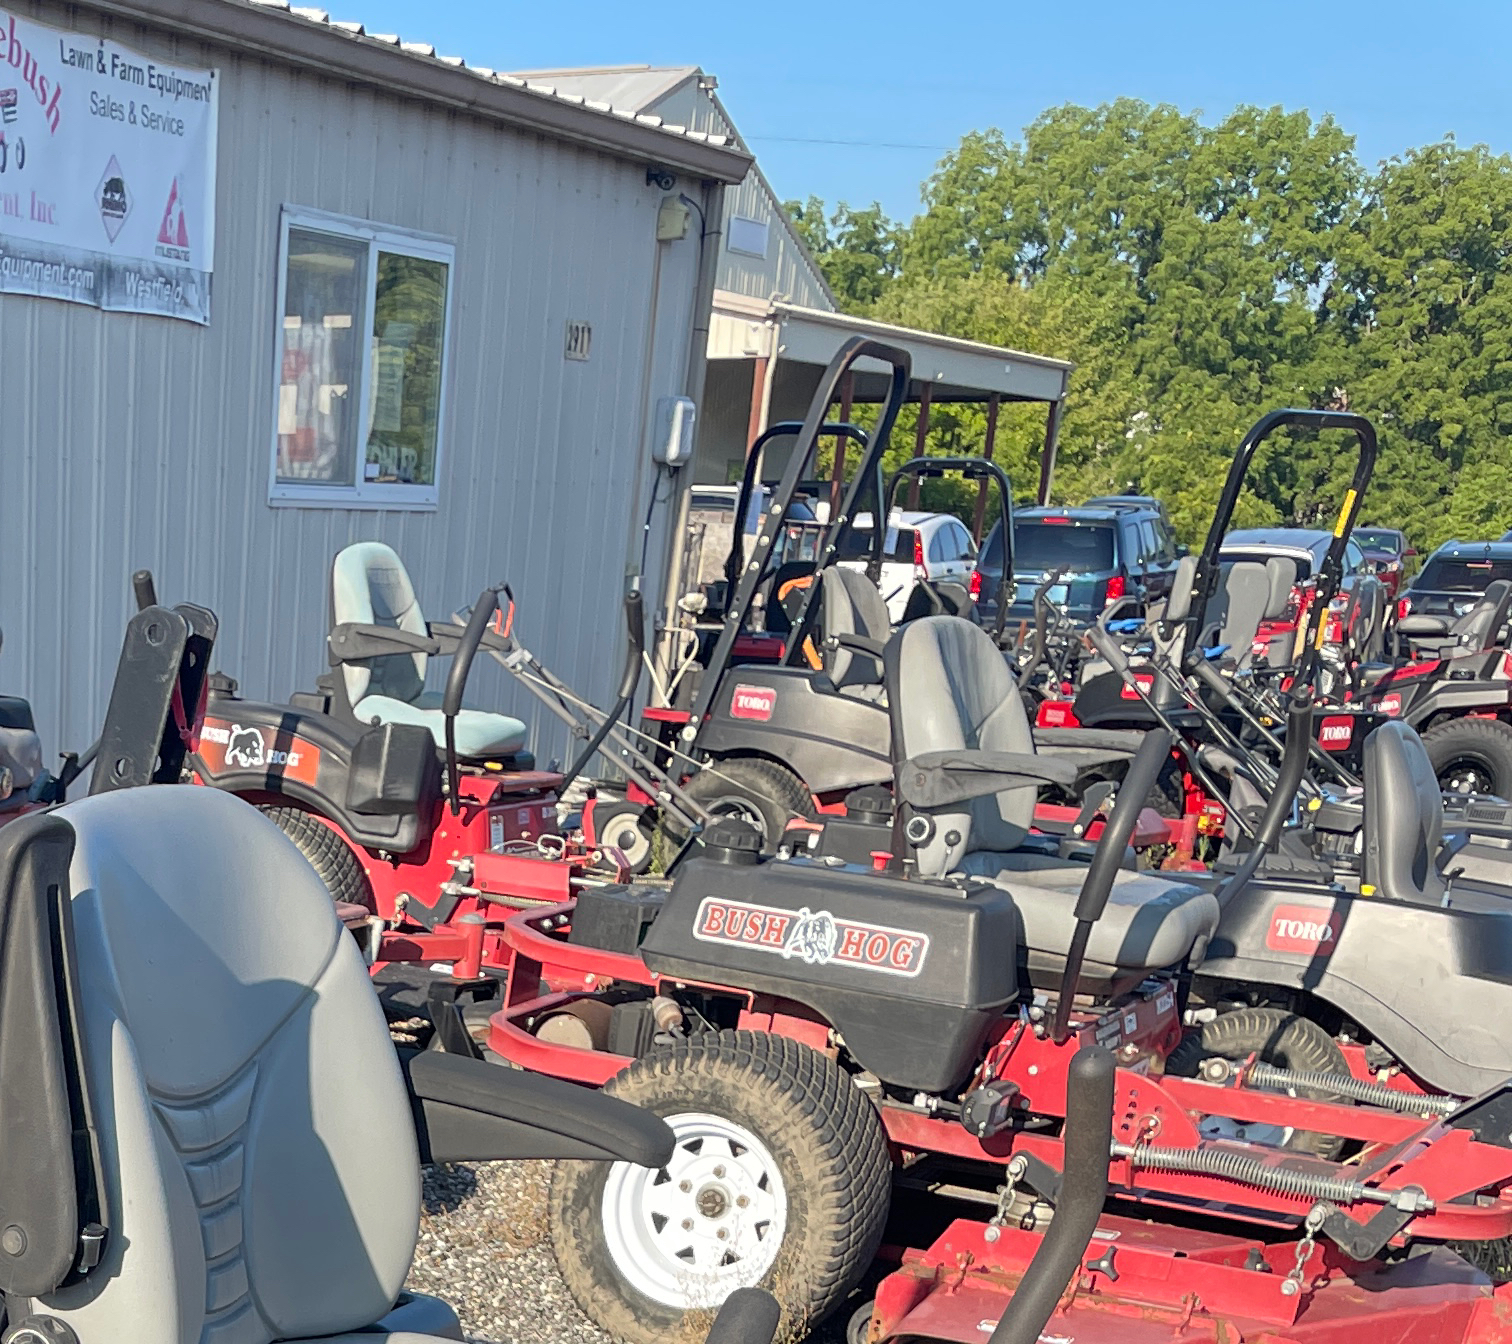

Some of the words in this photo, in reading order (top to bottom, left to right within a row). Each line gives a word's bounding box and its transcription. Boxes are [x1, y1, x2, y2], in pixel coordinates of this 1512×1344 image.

[59, 38, 93, 72] Lawn
[96, 50, 107, 75] &
[111, 53, 145, 87] Farm
[90, 91, 125, 122] Sales
[128, 101, 137, 125] &
[141, 104, 185, 137] Service
[737, 695, 771, 711] TORO
[1322, 726, 1351, 741] TORO
[266, 748, 300, 767] HOG
[702, 904, 790, 945] BUSH
[838, 927, 914, 968] HOG
[1275, 918, 1333, 942] TORO
